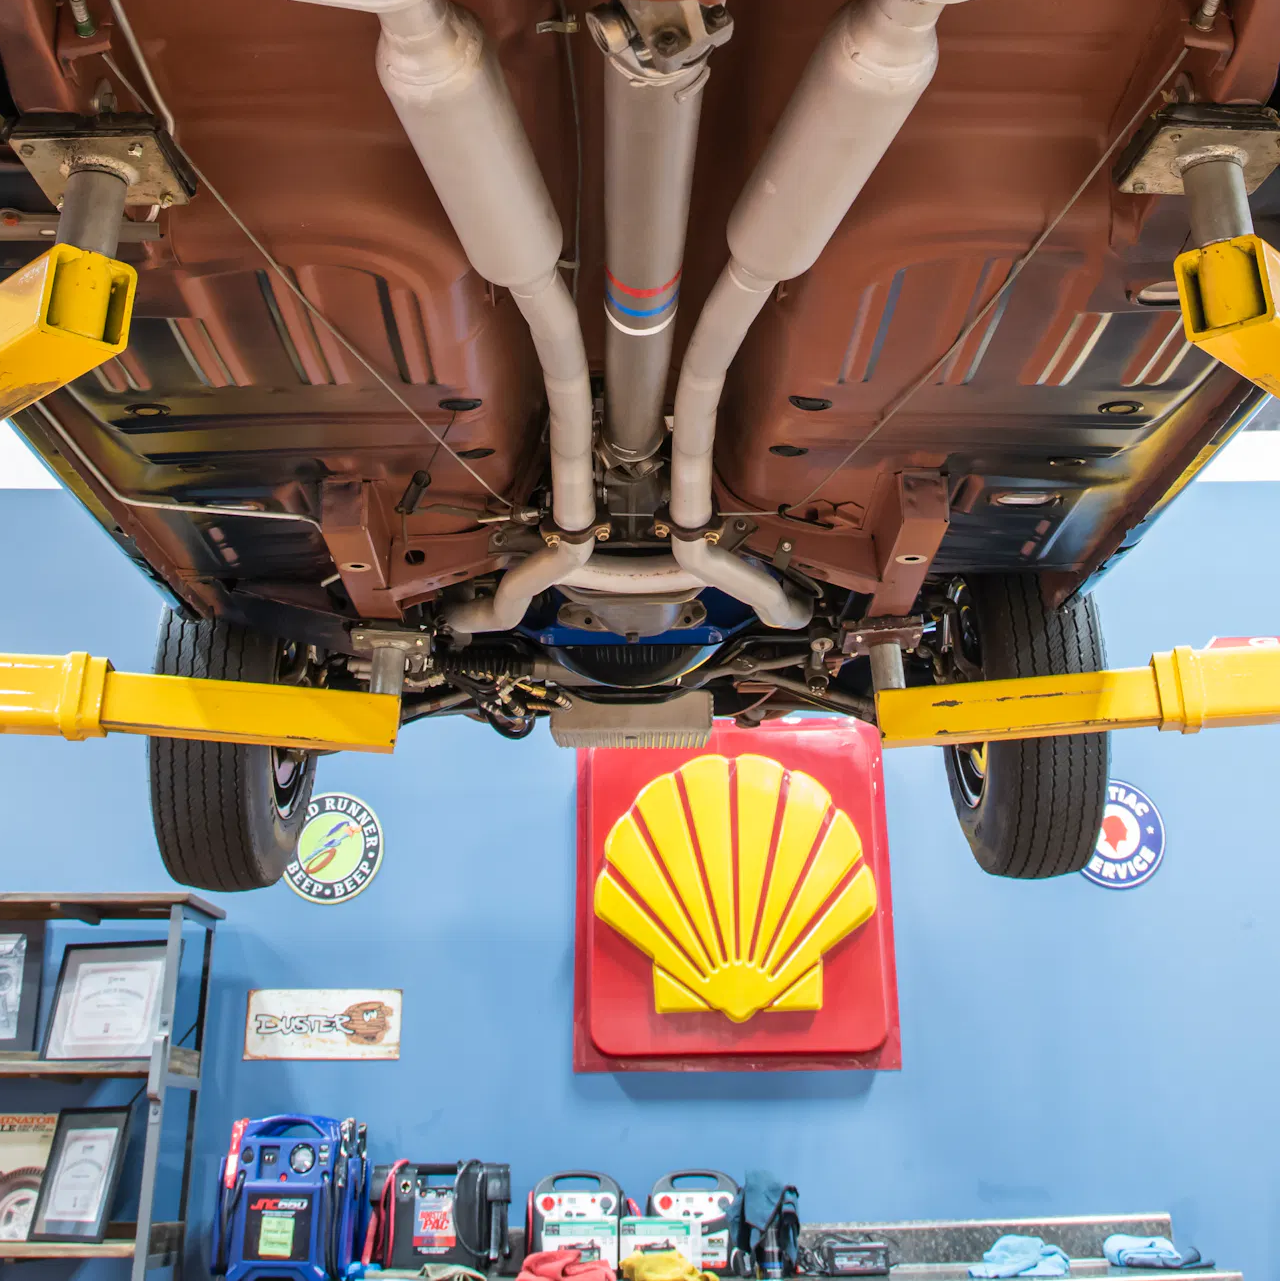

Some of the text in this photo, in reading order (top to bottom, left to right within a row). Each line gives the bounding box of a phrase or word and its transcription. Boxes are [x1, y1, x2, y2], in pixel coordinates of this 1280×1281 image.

[1107, 785, 1150, 817] TIAC
[324, 798, 378, 849] RUNNER
[286, 860, 371, 897] BEEP BEEP
[1087, 845, 1156, 880] ERVICE
[255, 1013, 356, 1035] DUSTER
[250, 1198, 308, 1210] JNC660
[422, 1218, 450, 1231] PAC
